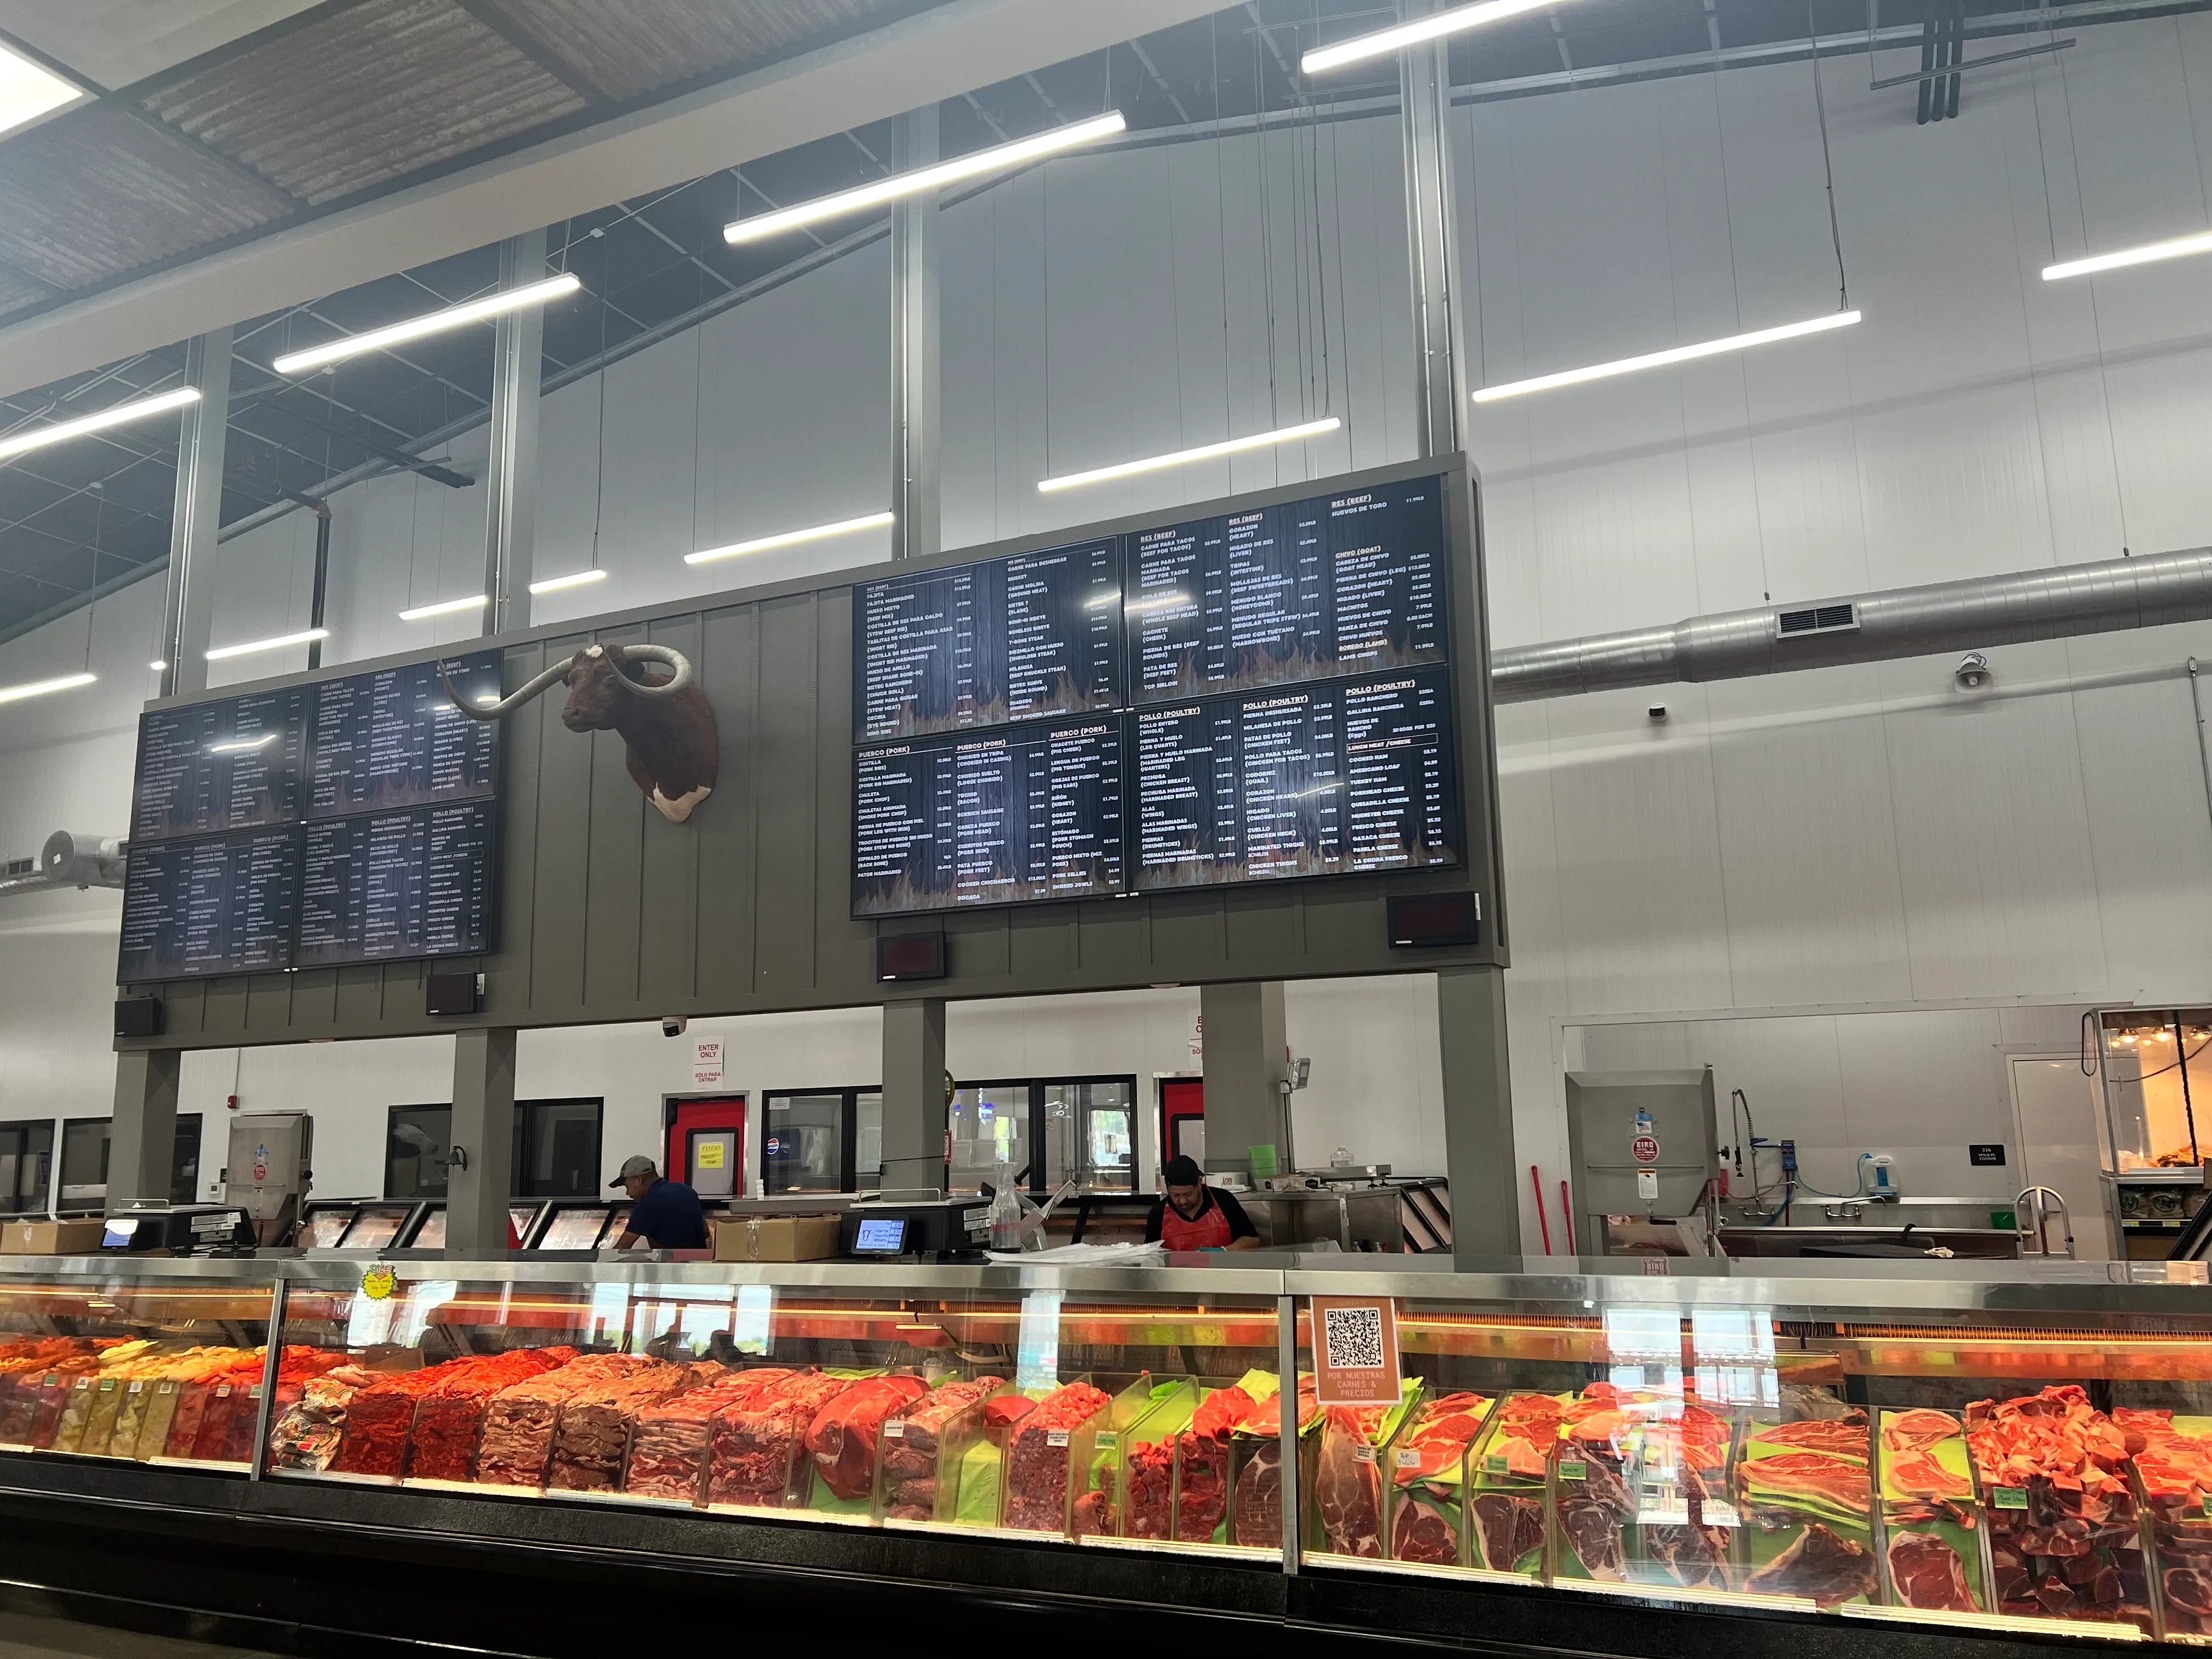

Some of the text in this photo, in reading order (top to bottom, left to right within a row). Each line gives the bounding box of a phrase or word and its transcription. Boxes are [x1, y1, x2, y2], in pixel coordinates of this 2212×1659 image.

[1331, 494, 1371, 508] RES (BEEF)
[1332, 507, 1357, 516] HUEVOS
[1369, 501, 1387, 510] TORO
[1229, 513, 1262, 526] RES (BEEF)
[1229, 523, 1257, 533] CORAZON
[1141, 530, 1175, 543] RES (BEEF)
[1229, 531, 1253, 540] (HEART)
[1229, 549, 1251, 558] (LIVER)
[1335, 545, 1380, 559] CHIVO (GOAT)
[1230, 561, 1250, 569] TRIPAS
[1335, 557, 1359, 566] CABEZA
[1336, 565, 1355, 573] (GOAT
[1337, 602, 1368, 612] MACHITOS
[1338, 613, 1361, 622] HUEVOS
[1143, 627, 1168, 635] CACHETE
[1232, 635, 1280, 647] (MARROWBONE)
[1346, 680, 1415, 696] POLLO (POULTRY)
[1367, 693, 1398, 701] RANCHERO
[1243, 695, 1308, 710] POLLO (POULTRY)
[1139, 707, 1200, 721] POLLO (POULTRY)
[1265, 707, 1301, 716] DESHUESADA
[1244, 722, 1271, 730] MILANESA
[1051, 726, 1106, 738] PUERCO (PORK)
